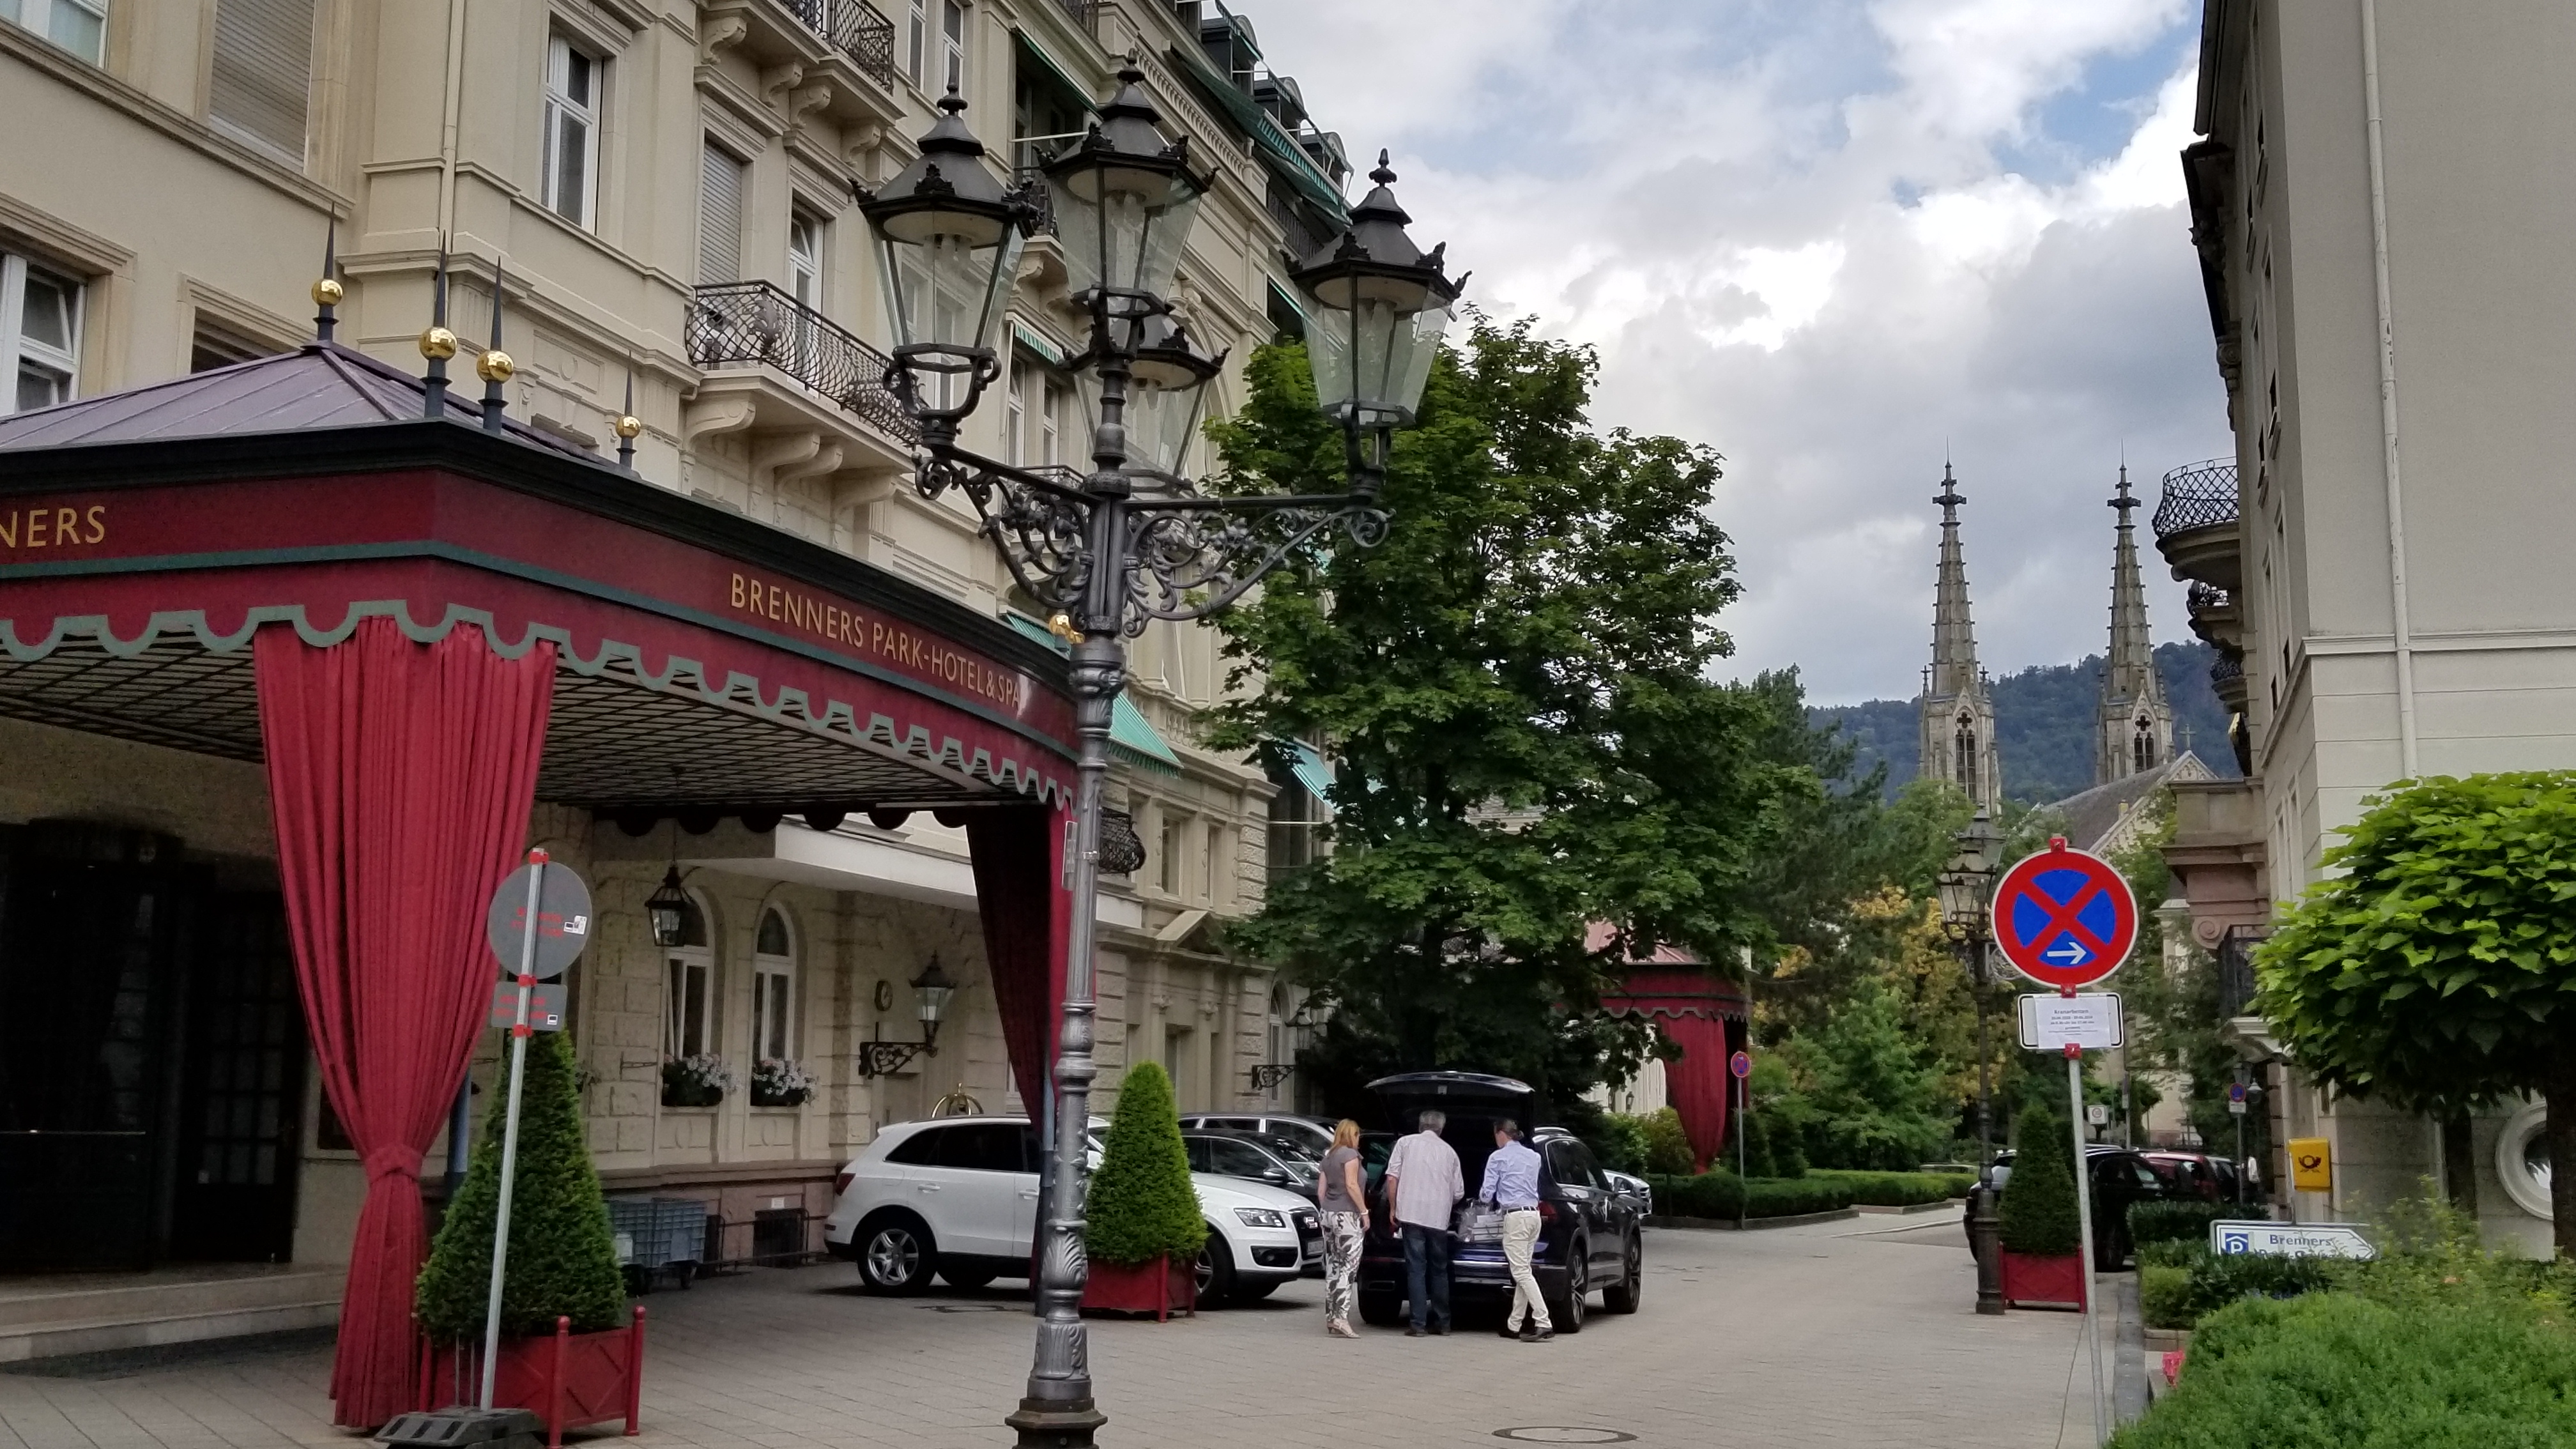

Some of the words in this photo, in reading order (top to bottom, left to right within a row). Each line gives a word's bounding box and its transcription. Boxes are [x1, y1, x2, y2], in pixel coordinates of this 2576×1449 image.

[731, 573, 864, 648] BRENNERS
[872, 622, 984, 695] PARK-HOTEL
[997, 675, 1021, 708] SPA
[2269, 1234, 2332, 1246] Brenners
[2230, 1241, 2243, 1254] P
